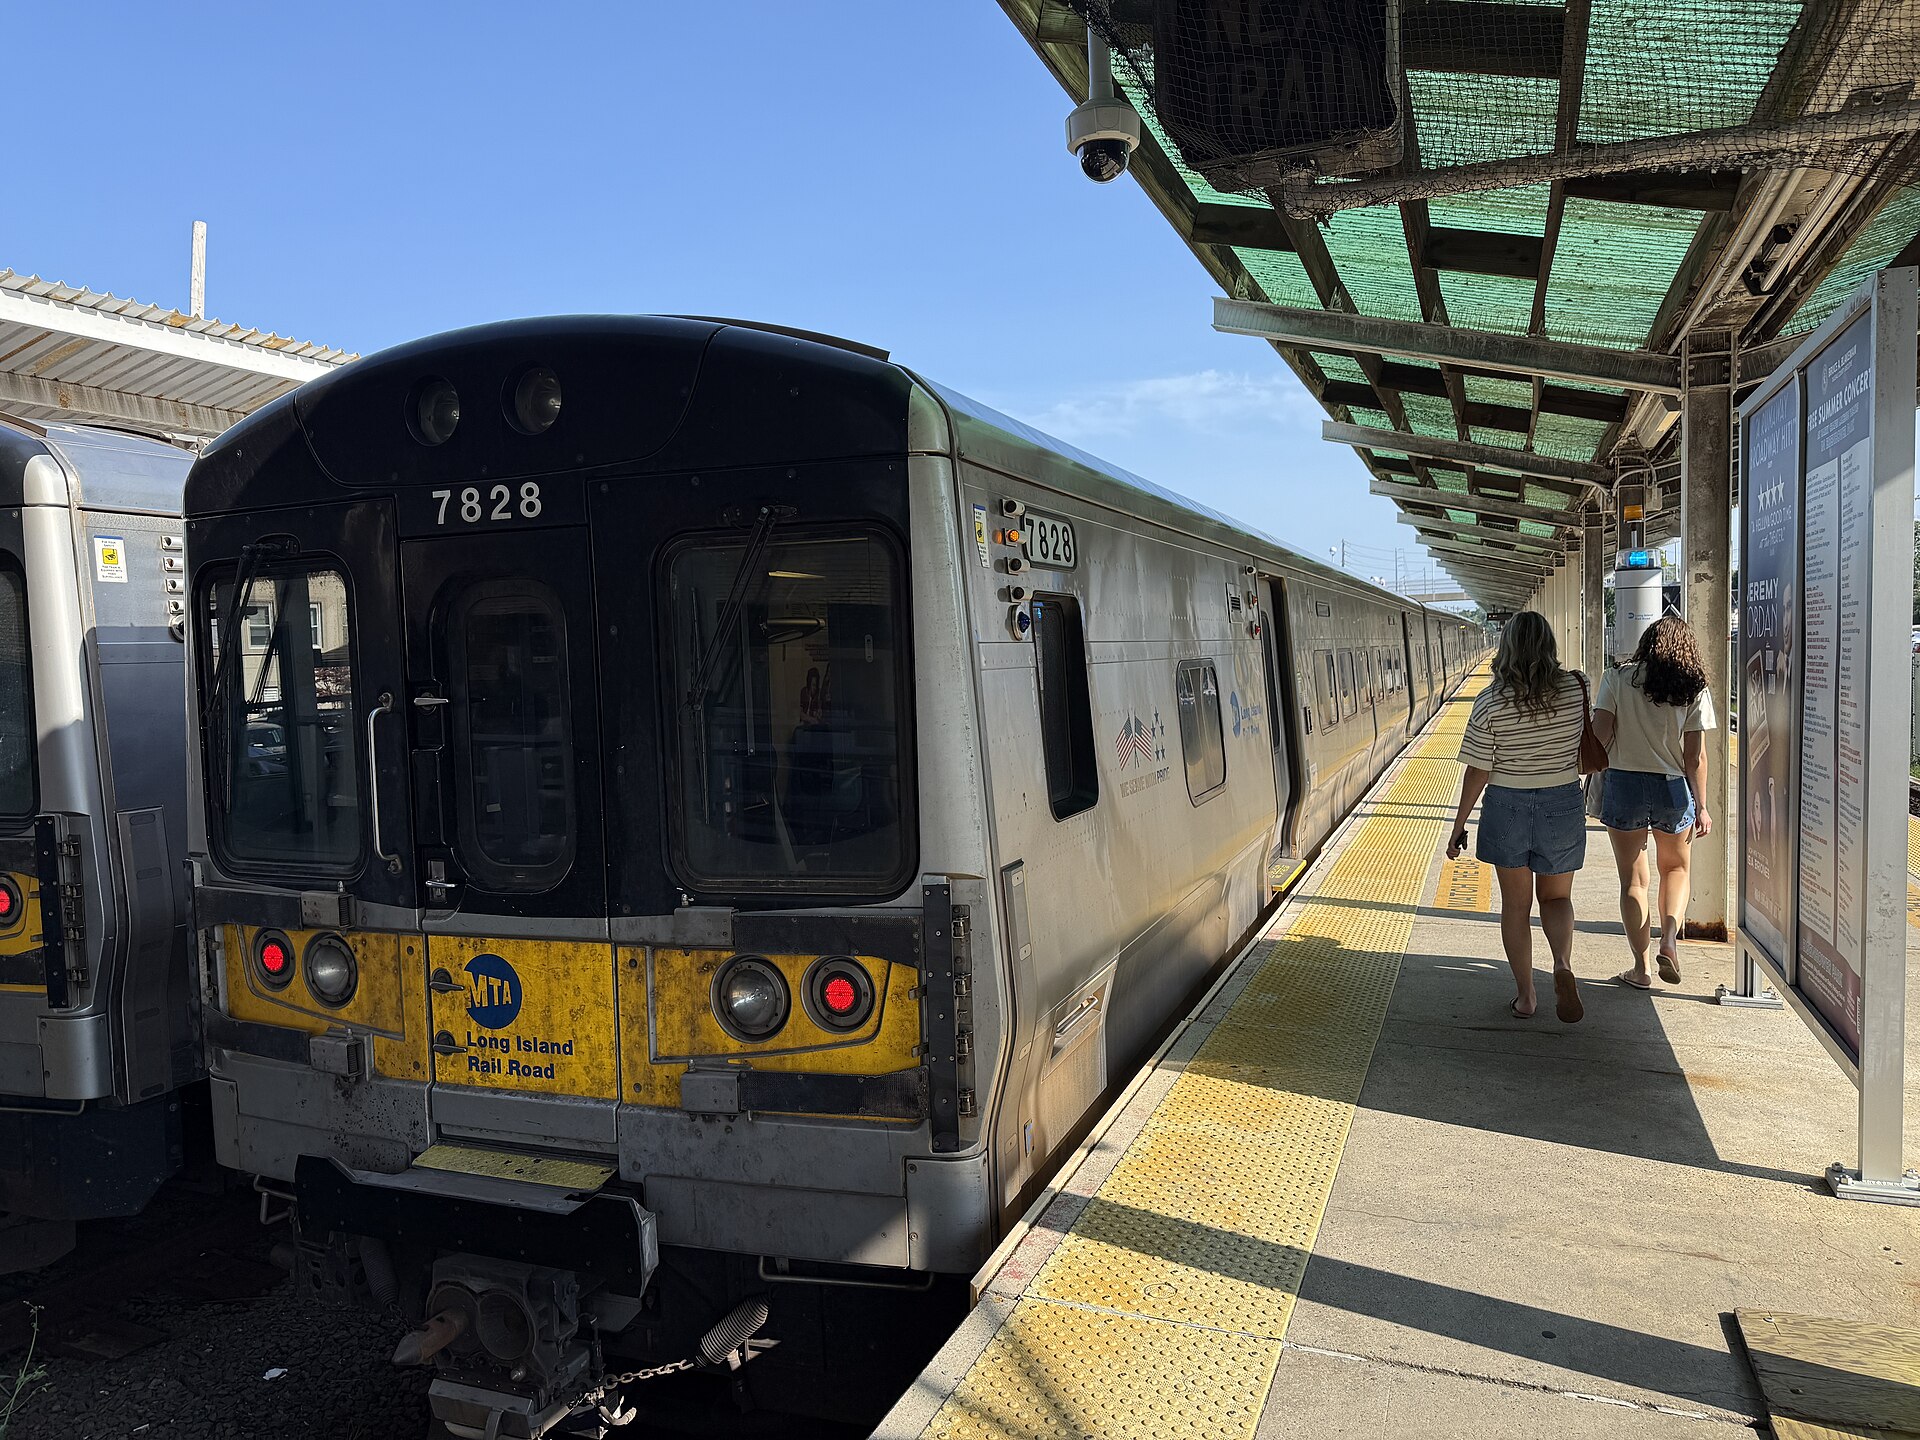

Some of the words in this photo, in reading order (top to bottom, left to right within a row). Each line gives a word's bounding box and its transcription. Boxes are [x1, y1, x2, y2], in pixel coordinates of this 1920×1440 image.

[1807, 412, 1817, 433] FREE
[1818, 391, 1842, 425] SUMMER
[432, 481, 542, 525] 7828
[1026, 518, 1072, 563] 7828
[1747, 577, 1779, 602] JEREMY
[1747, 603, 1778, 638] ORDAN
[464, 970, 512, 1008] MTA
[466, 1031, 510, 1053] Long
[517, 1036, 573, 1055] Island
[468, 1056, 501, 1074] Rail
[509, 1060, 555, 1079] Road
